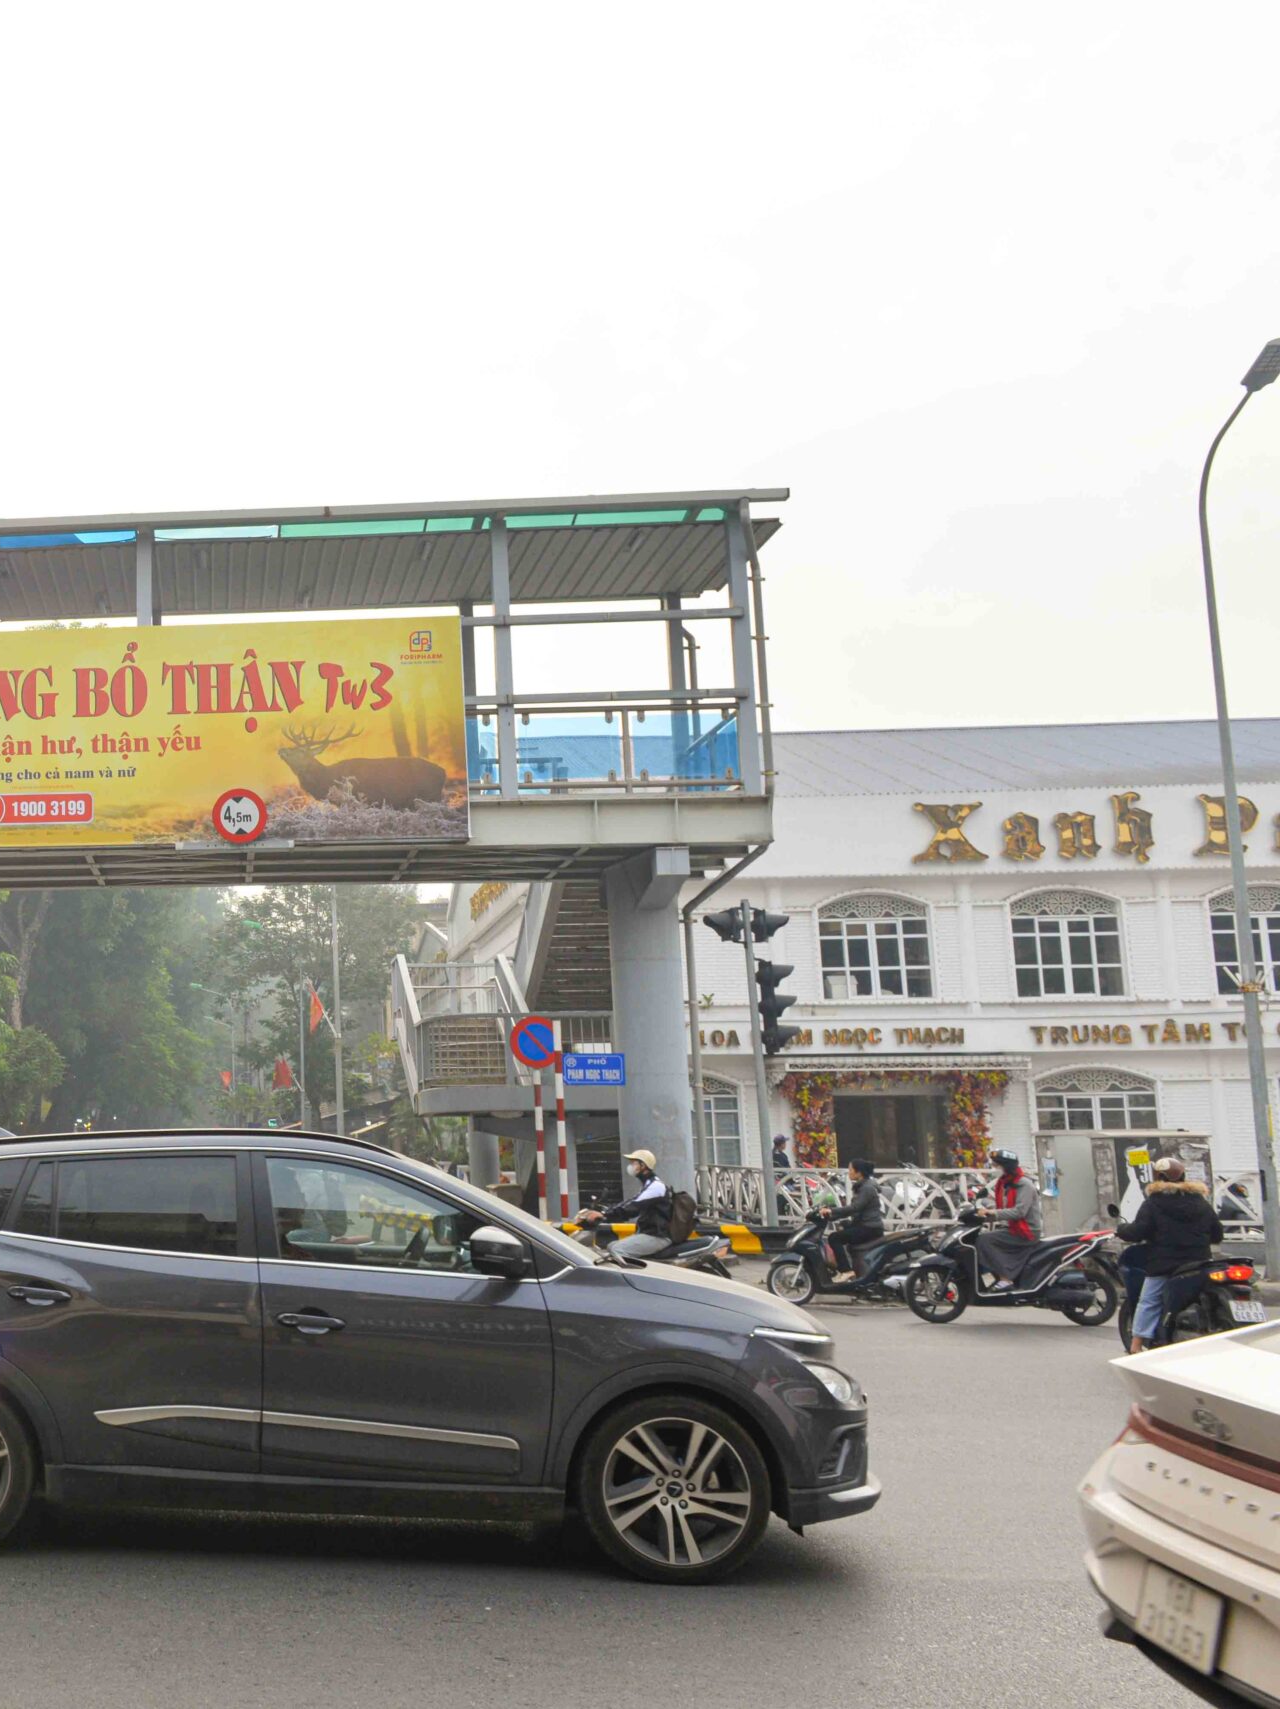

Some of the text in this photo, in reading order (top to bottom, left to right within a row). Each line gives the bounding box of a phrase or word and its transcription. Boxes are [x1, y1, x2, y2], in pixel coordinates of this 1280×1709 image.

[72, 641, 149, 718] BỔ
[161, 648, 307, 733] THẬN
[41, 734, 84, 760] hư,
[90, 731, 150, 761] thận
[157, 724, 202, 758] yếu
[16, 768, 42, 780] cho
[45, 766, 61, 780] cả
[64, 770, 95, 780] nam
[98, 766, 114, 779] và
[117, 767, 138, 778] nữ
[12, 799, 86, 817] 1900 3199
[223, 805, 253, 828] 4,5m
[912, 790, 1156, 864] Xanh
[823, 1027, 883, 1050] NGỌC
[893, 1026, 965, 1049] THẠCH
[1030, 1023, 1133, 1045] TRUNG
[1140, 1017, 1212, 1043] TÂM
[587, 1056, 608, 1066] PHỐ
